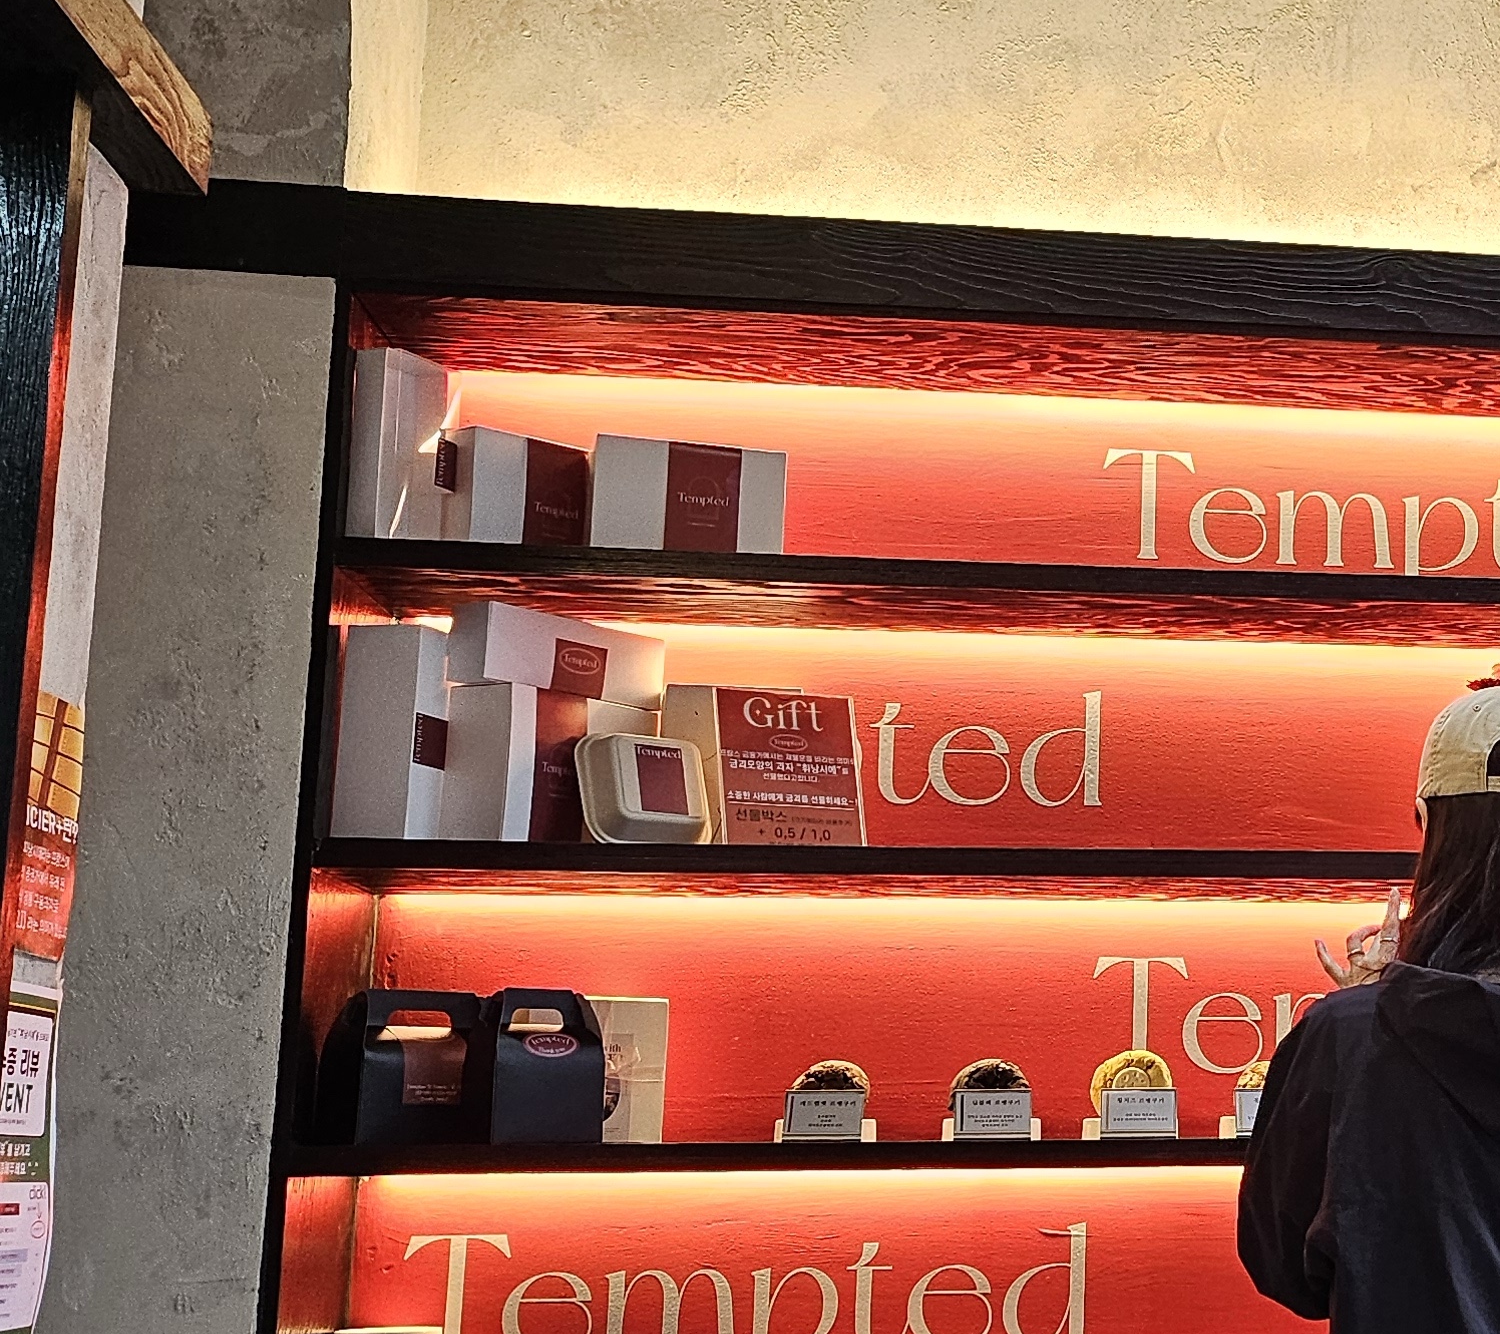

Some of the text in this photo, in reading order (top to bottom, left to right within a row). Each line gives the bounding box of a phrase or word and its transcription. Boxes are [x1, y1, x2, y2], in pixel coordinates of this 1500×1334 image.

[677, 491, 731, 508] Tempted
[533, 501, 579, 521] Tempted
[563, 653, 598, 669] Tempted
[743, 696, 824, 732] Gift
[635, 744, 682, 760] Tempted
[19, 1049, 40, 1079] 리뷰
